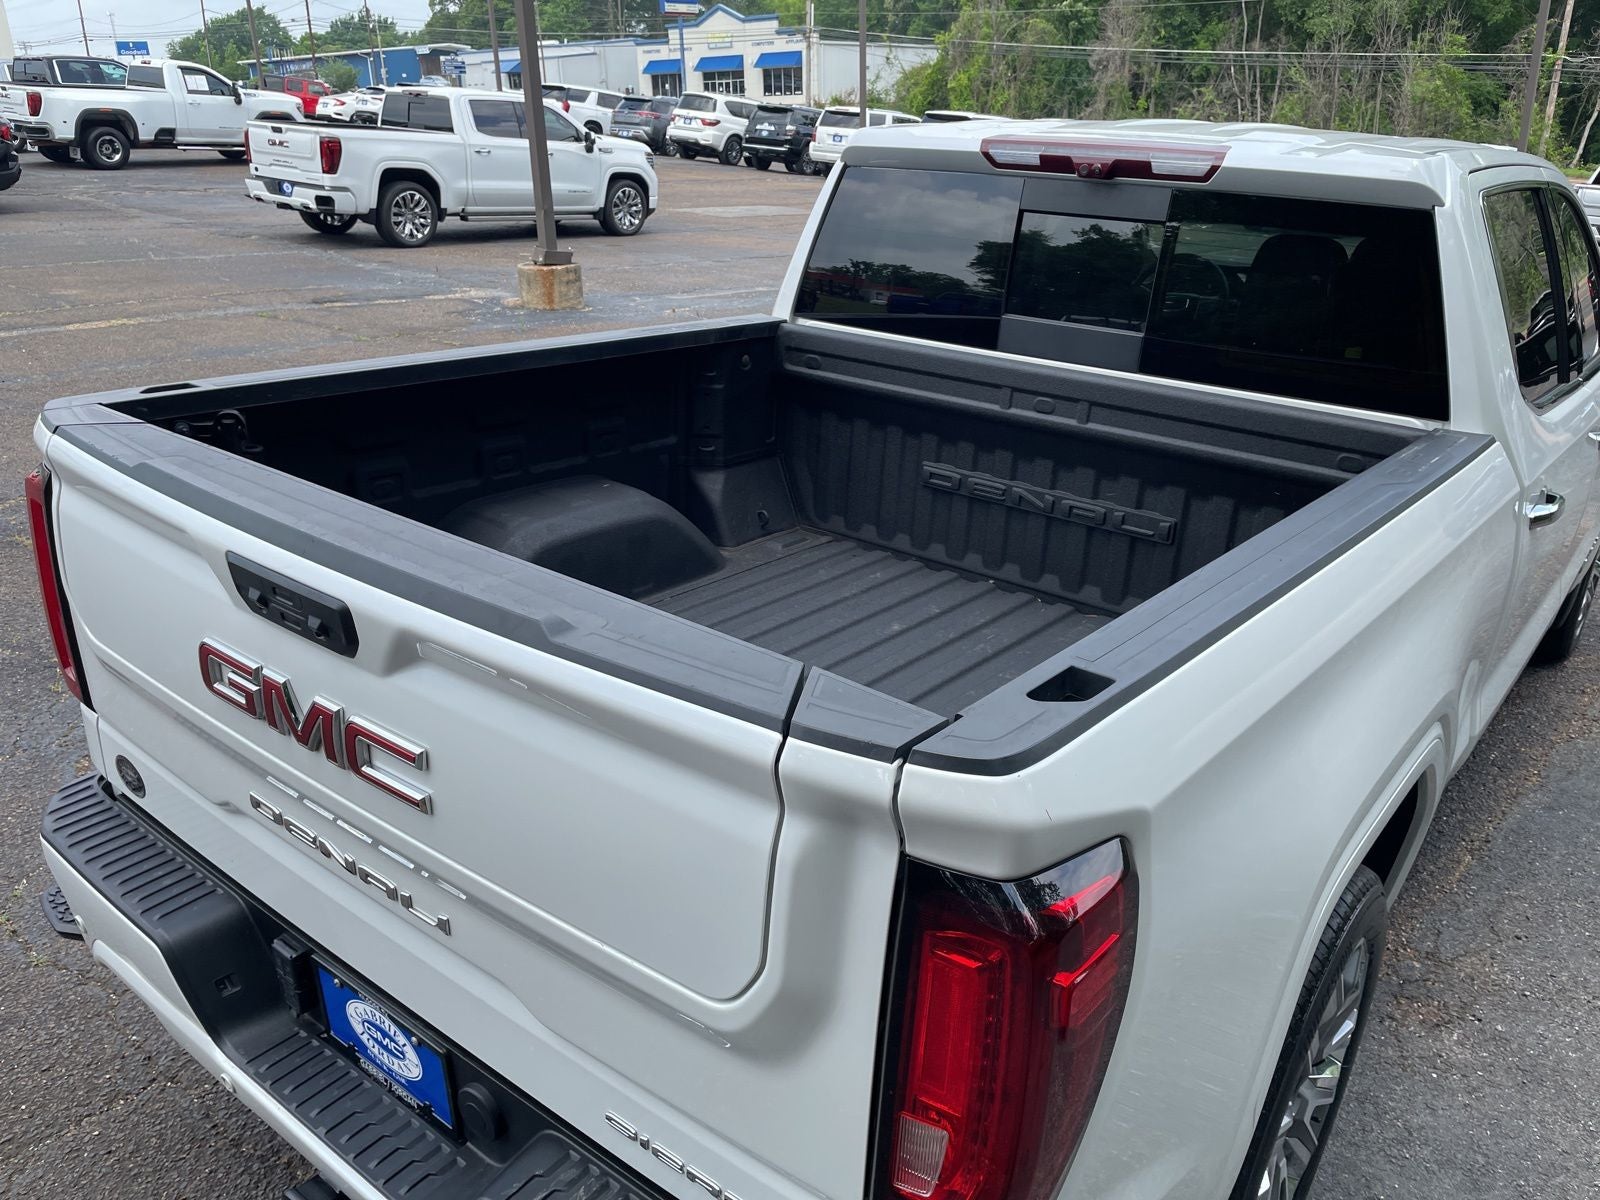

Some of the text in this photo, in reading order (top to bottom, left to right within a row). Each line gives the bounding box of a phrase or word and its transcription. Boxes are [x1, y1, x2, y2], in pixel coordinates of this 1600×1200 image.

[267, 138, 290, 148] GMC
[198, 635, 434, 816] GMC
[249, 791, 450, 936] DENALI
[354, 1006, 409, 1055] GABRIEL
[359, 1031, 414, 1075] JORDAN
[363, 1021, 405, 1060] GMC
[605, 1110, 743, 1200] SIER
